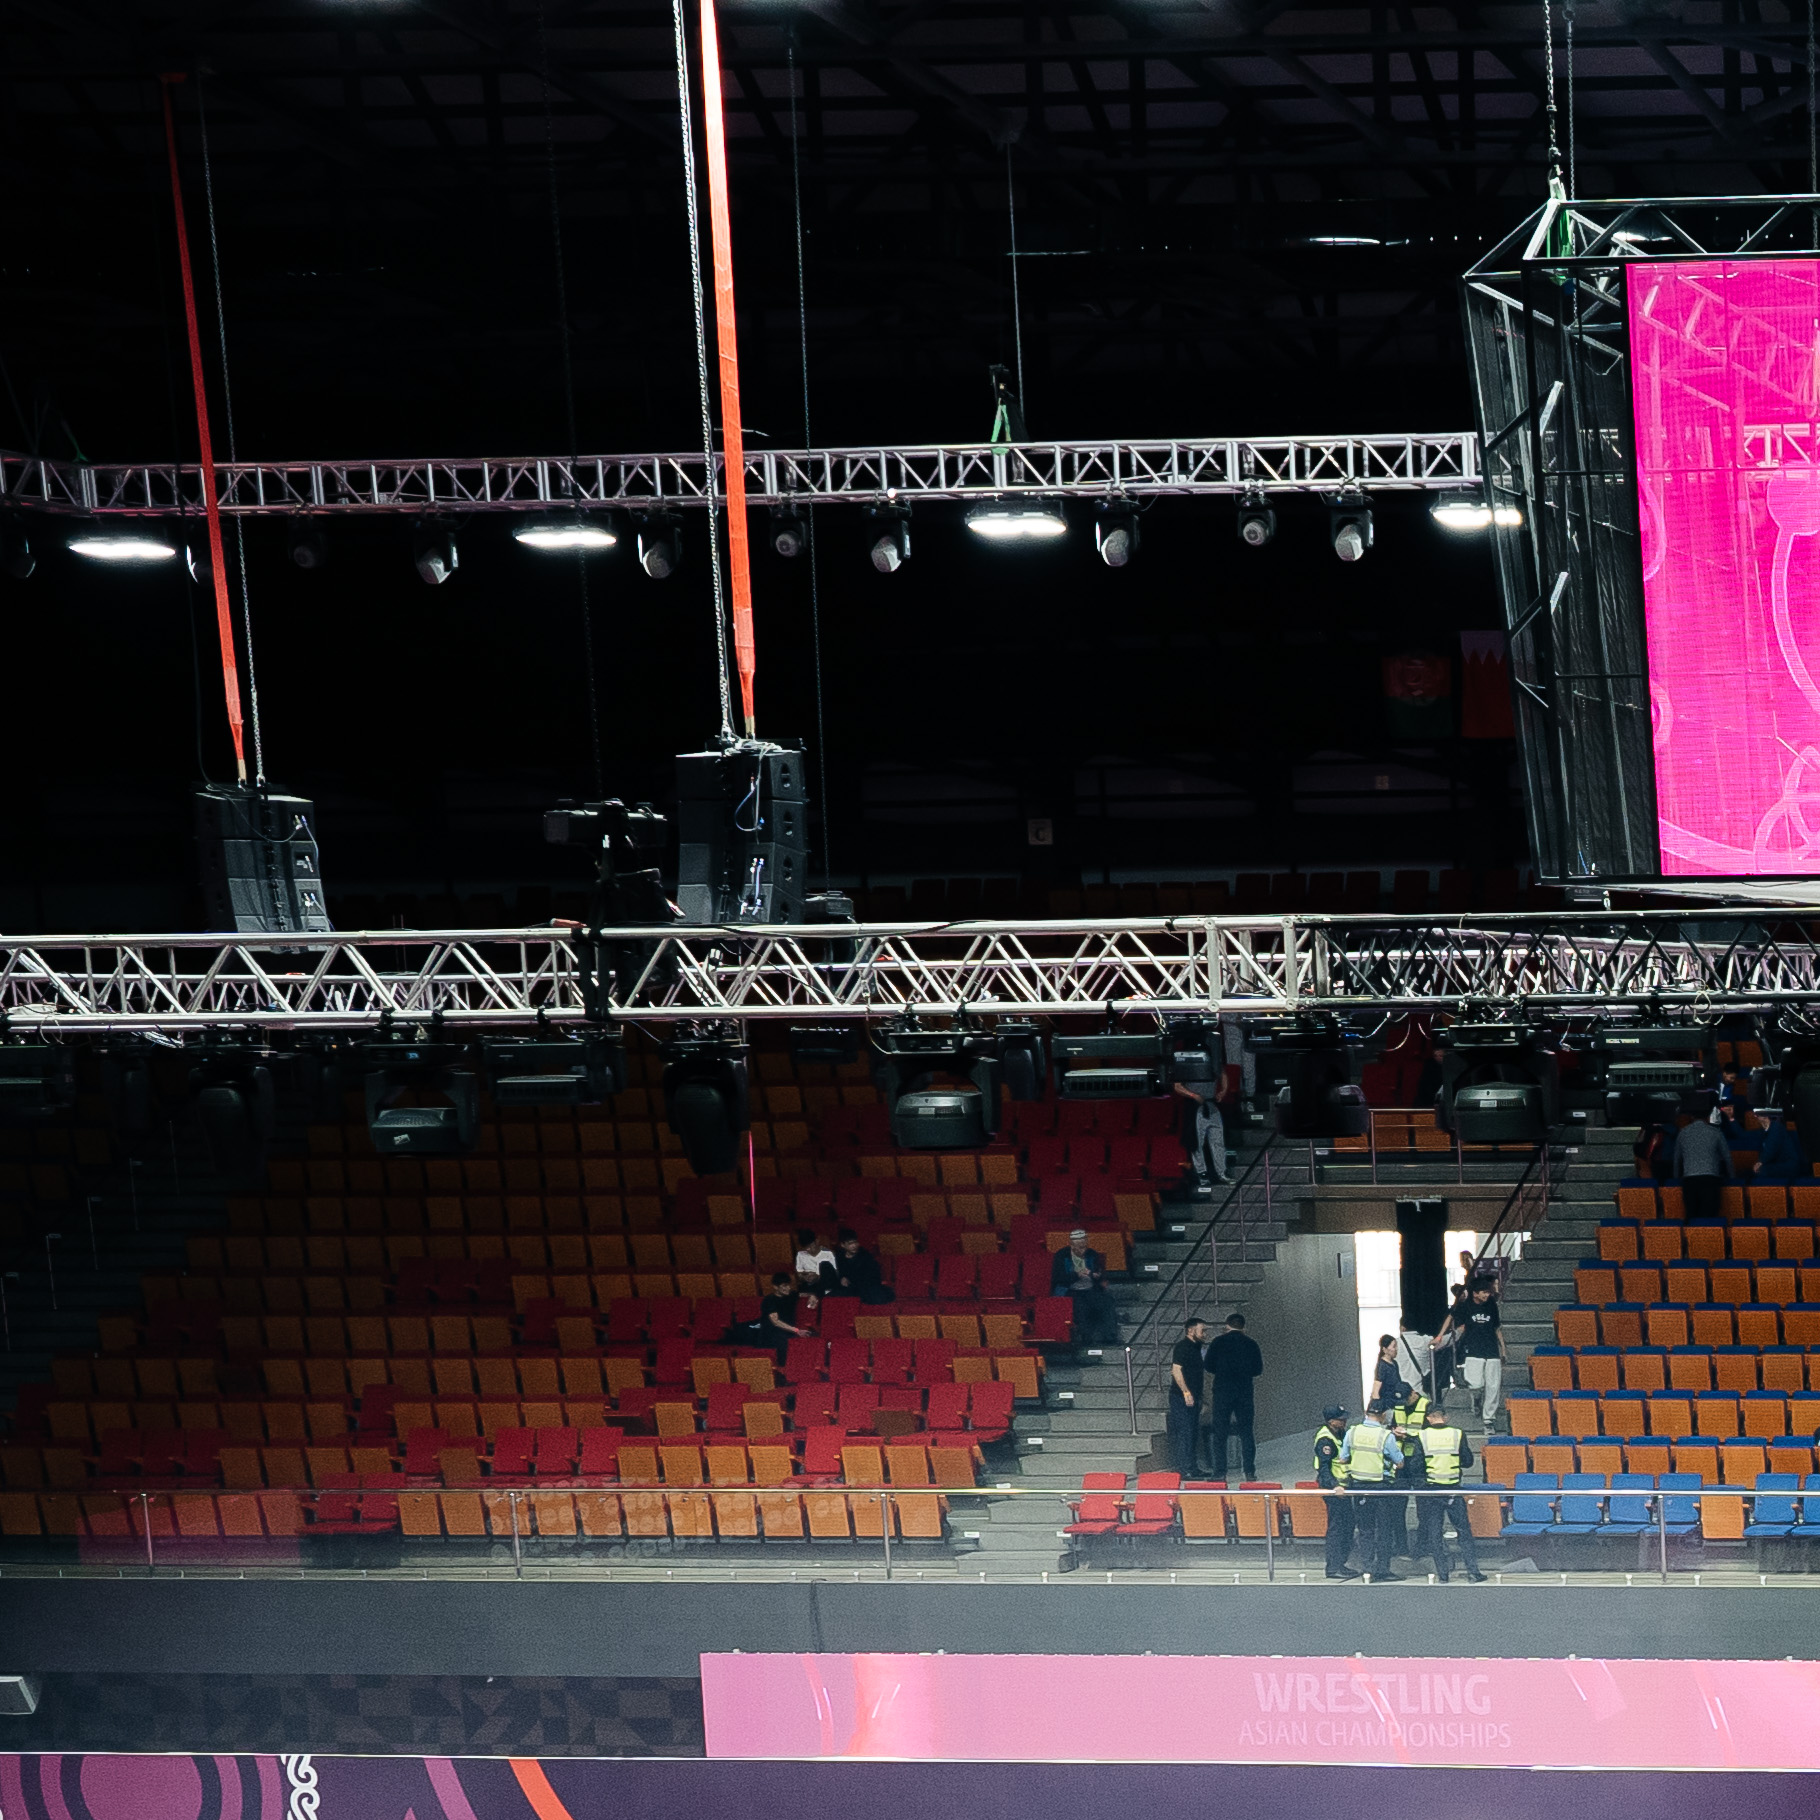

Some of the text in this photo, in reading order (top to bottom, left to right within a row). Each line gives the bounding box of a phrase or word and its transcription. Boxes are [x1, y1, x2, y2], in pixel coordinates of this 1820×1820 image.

[1254, 1674, 1491, 1716] WRESTLING
[1239, 1721, 1511, 1749] ASIAN CHAMPIONSHIPS
